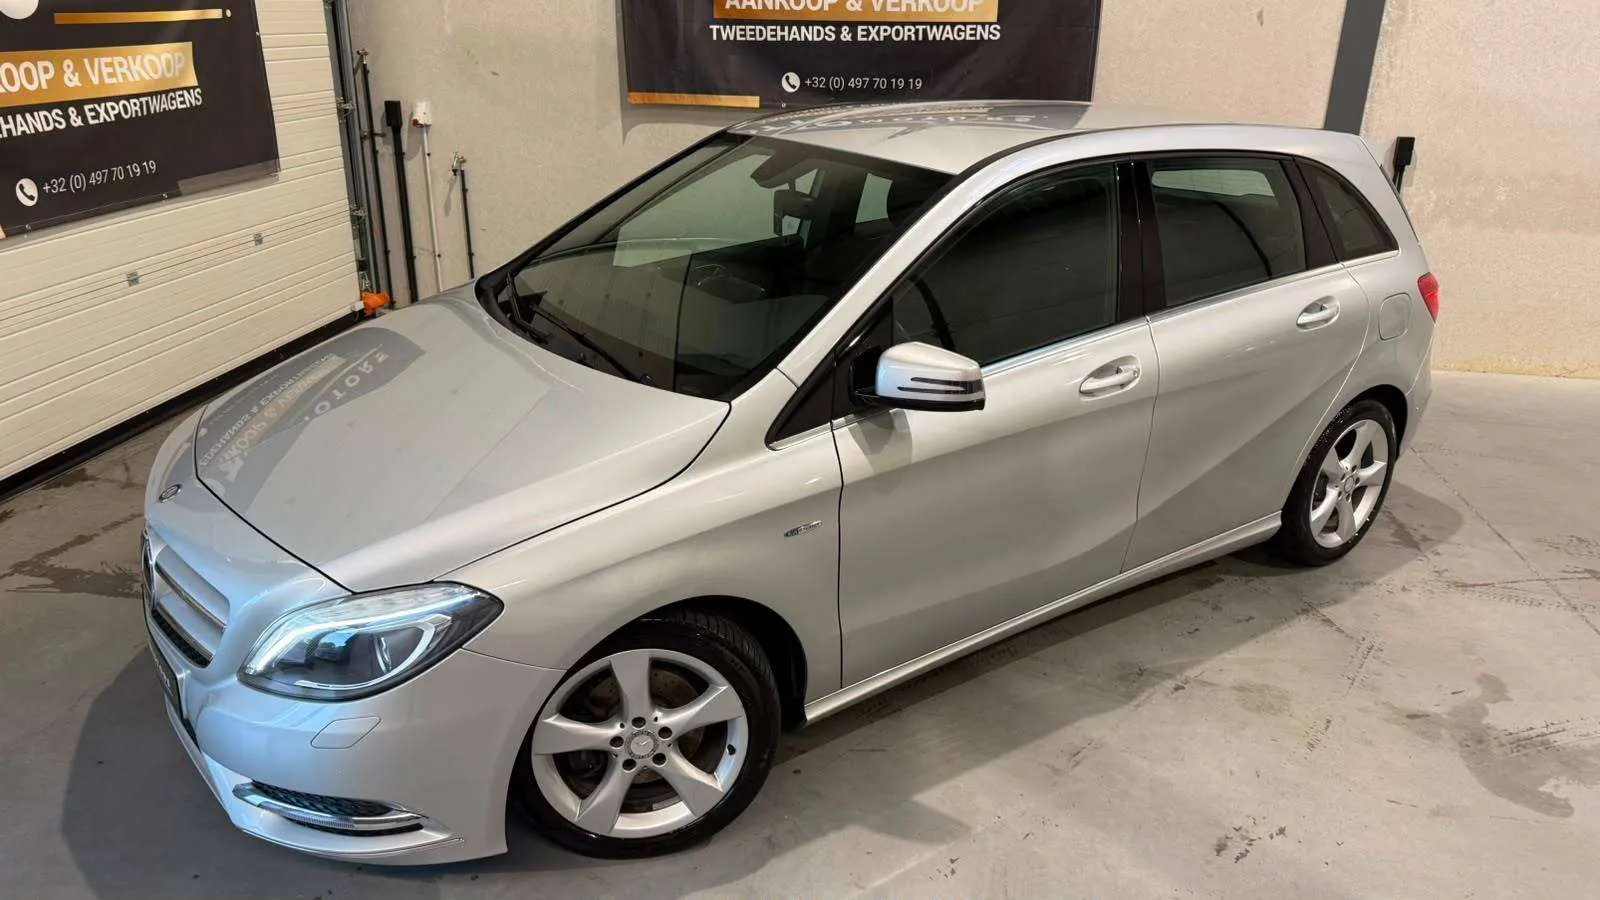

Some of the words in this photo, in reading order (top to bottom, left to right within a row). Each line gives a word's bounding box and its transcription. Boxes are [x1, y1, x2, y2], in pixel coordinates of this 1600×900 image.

[709, 25, 836, 41] TWEEDEHANDS
[840, 25, 853, 42] &
[857, 24, 1001, 42] EXPORTWAGENS
[0, 61, 55, 94] OOP
[62, 59, 83, 88] &
[83, 52, 185, 86] VERKOOP
[804, 76, 826, 88] +32
[829, 76, 845, 91] (0)
[848, 77, 869, 89] 497
[873, 78, 887, 90] 70
[890, 78, 904, 90] 19
[907, 78, 922, 90] 19
[0, 108, 66, 138] HANDS
[68, 106, 84, 127] &
[84, 88, 202, 126] EXPORTWAGENS
[43, 177, 67, 193] +32
[69, 172, 87, 193] (0)
[89, 169, 109, 186] 497
[110, 166, 125, 181] 70
[126, 162, 141, 178] 19
[142, 160, 156, 174] 19
